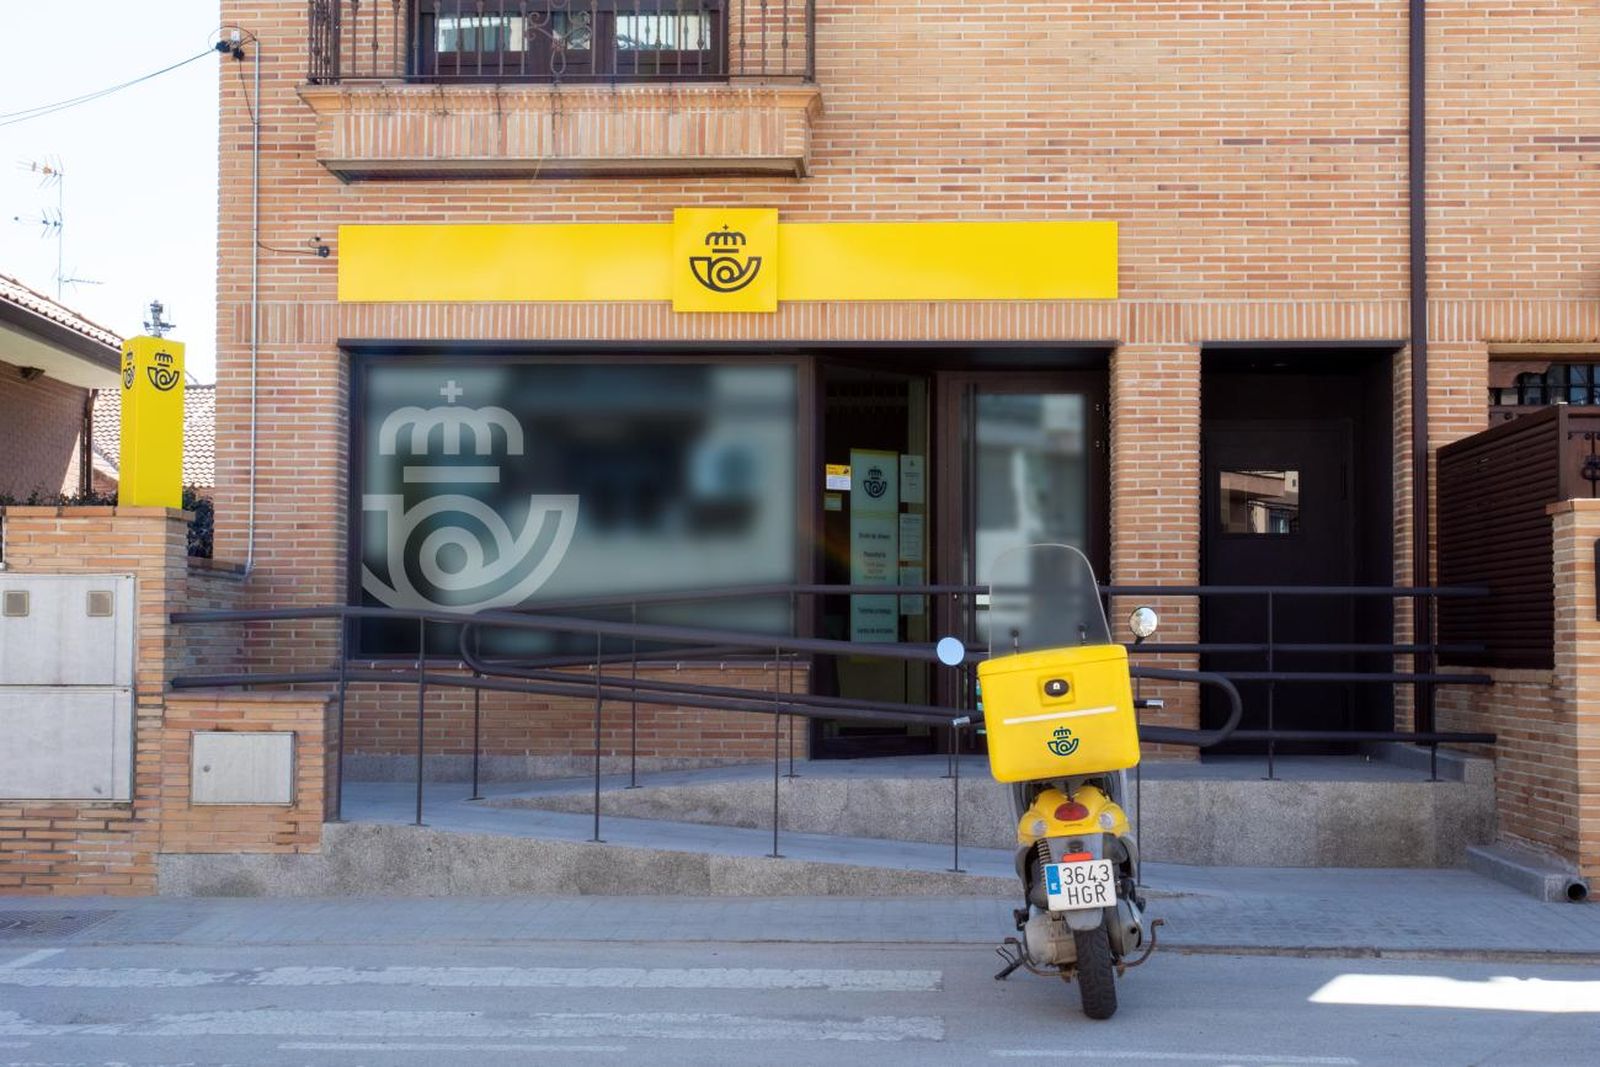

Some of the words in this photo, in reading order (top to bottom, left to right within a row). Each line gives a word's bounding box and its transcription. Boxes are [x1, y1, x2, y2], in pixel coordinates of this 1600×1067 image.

[1062, 864, 1110, 885] 3643
[1050, 882, 1057, 891] E
[1067, 885, 1107, 905] HGR
